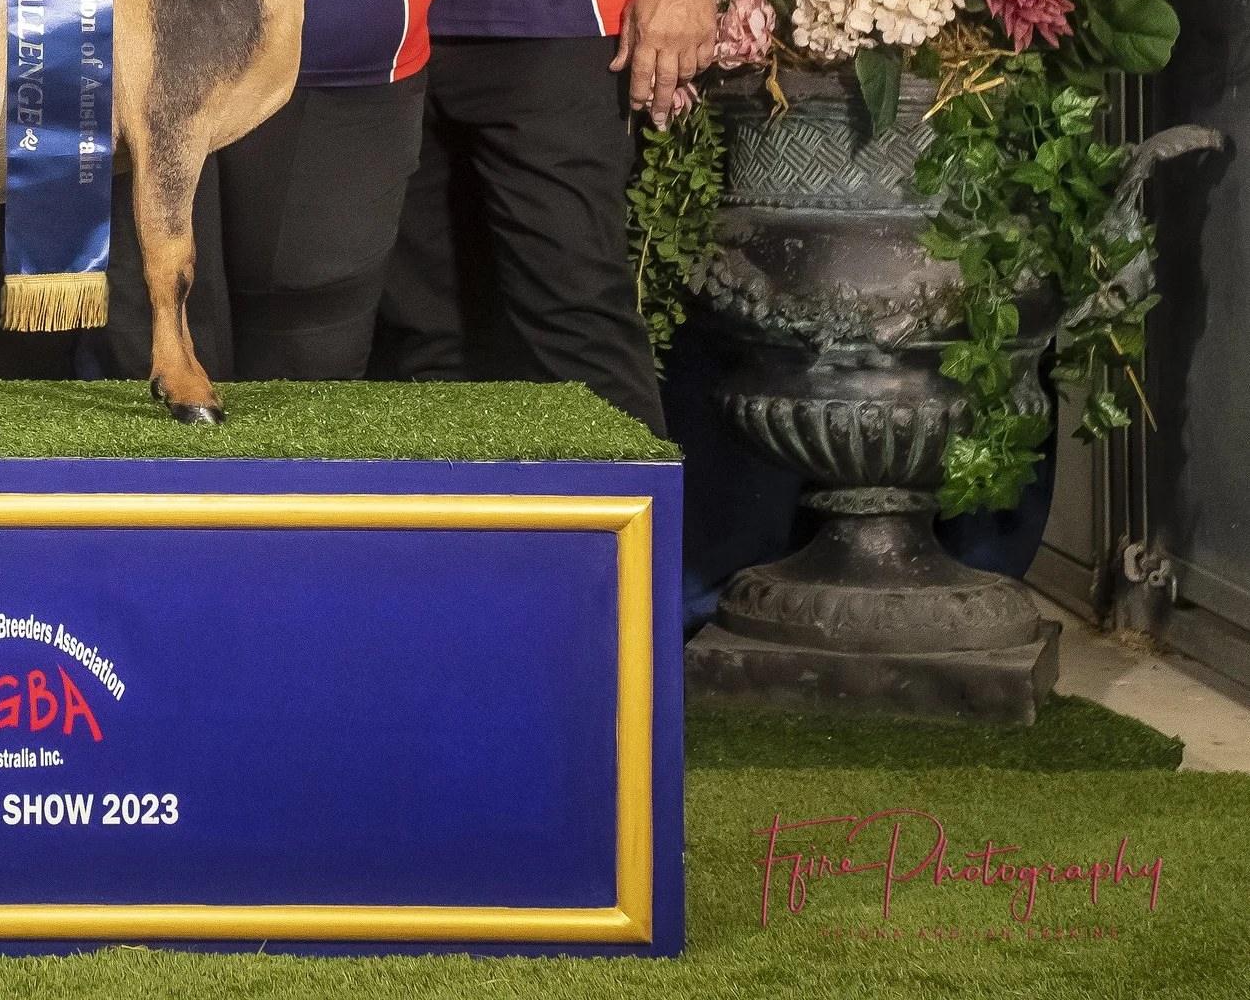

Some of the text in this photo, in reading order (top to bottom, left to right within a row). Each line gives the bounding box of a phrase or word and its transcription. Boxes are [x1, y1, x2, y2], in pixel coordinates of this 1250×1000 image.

[80, 41, 103, 69] of
[78, 75, 103, 186] Australia
[53, 623, 126, 701] Association
[40, 748, 64, 767] Inc.
[2, 794, 94, 825] SHOW
[102, 793, 179, 825] 2023
